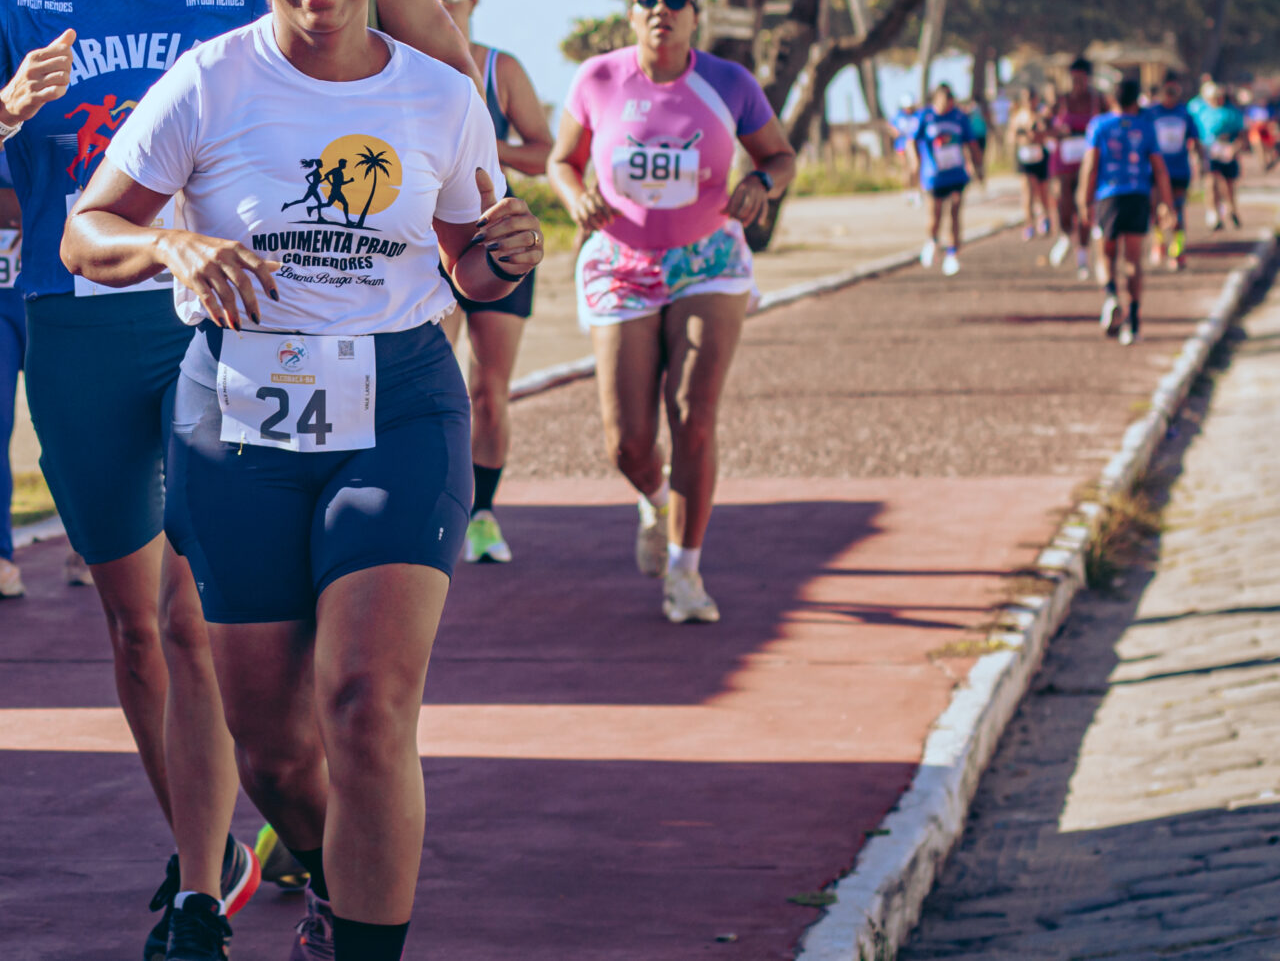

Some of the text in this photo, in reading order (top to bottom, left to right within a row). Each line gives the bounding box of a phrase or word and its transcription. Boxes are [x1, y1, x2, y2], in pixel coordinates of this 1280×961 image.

[66, 33, 202, 90] ARAVEL
[629, 151, 680, 181] 981
[252, 230, 407, 258] MOVIMENTA PRADO
[276, 265, 385, 288] Lorena Braga Team
[282, 252, 374, 272] CORREDORES
[256, 386, 332, 446] 24
